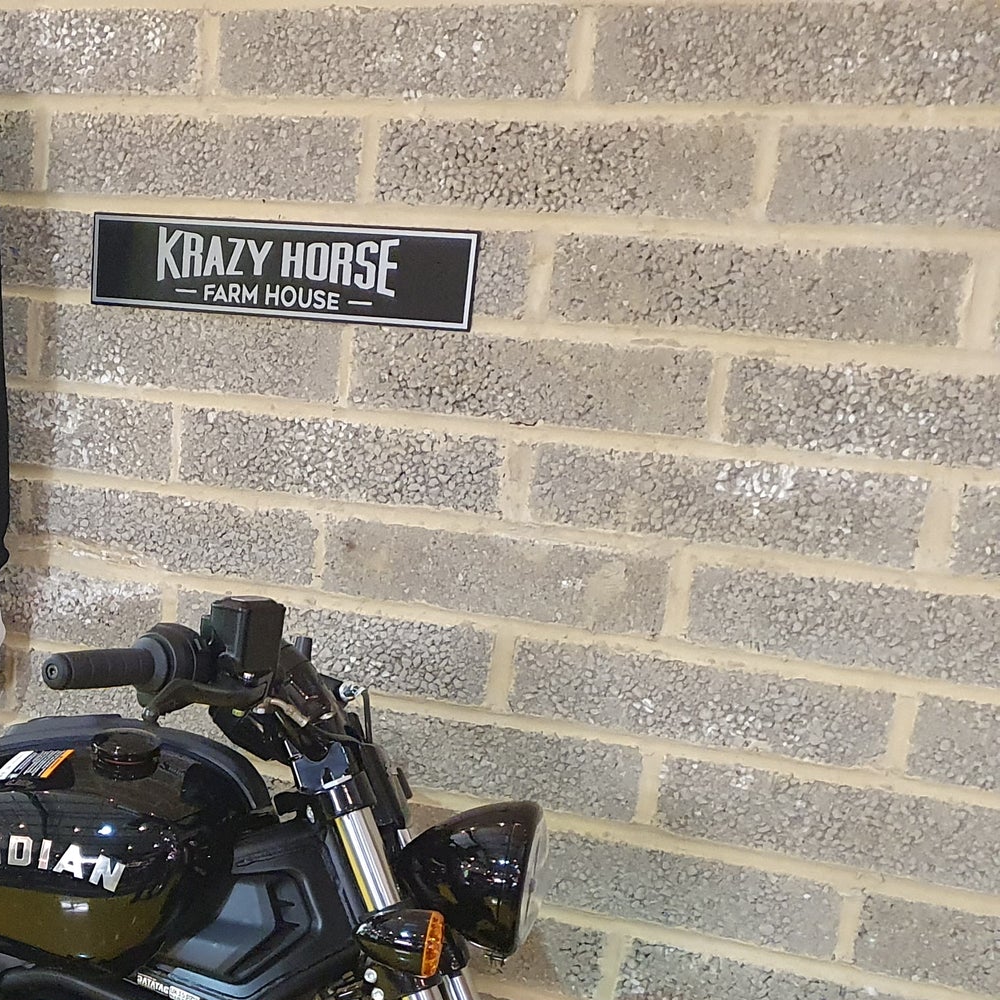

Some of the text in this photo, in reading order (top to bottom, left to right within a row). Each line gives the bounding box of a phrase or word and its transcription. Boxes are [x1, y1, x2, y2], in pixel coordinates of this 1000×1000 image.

[156, 226, 400, 298] KRAZY HORSE
[203, 283, 341, 311] FARM HOUSE
